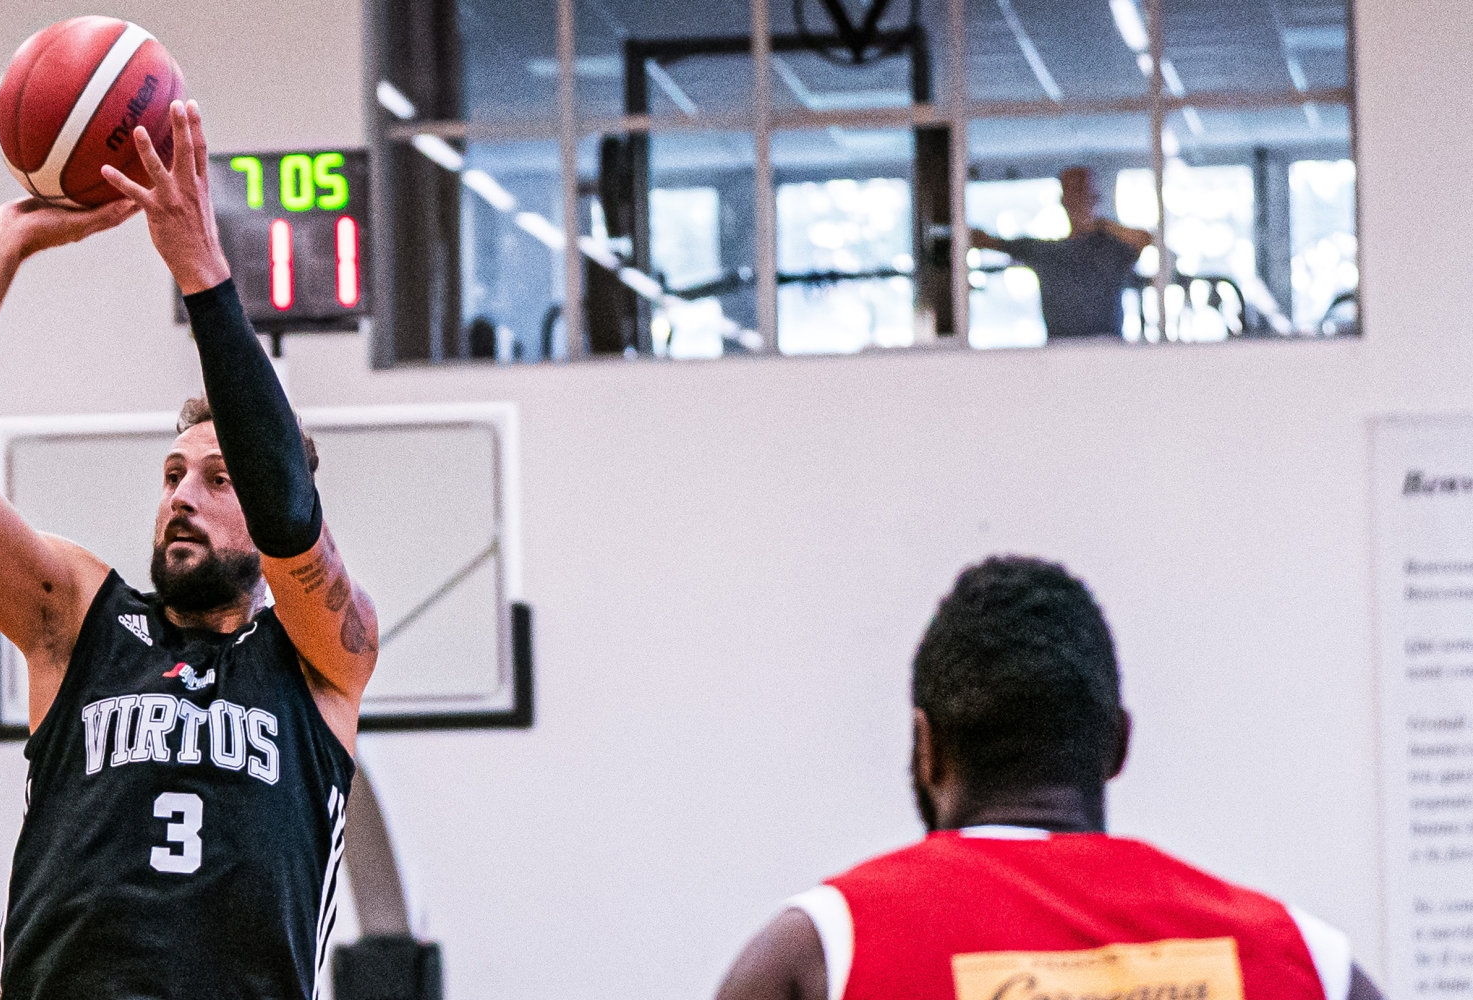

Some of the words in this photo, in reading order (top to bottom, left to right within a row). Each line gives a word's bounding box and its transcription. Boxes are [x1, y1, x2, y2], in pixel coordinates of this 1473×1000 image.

[106, 74, 159, 152] molten
[118, 614, 153, 647] adidas
[82, 693, 279, 785] VIRTUS
[149, 792, 203, 874] 3
